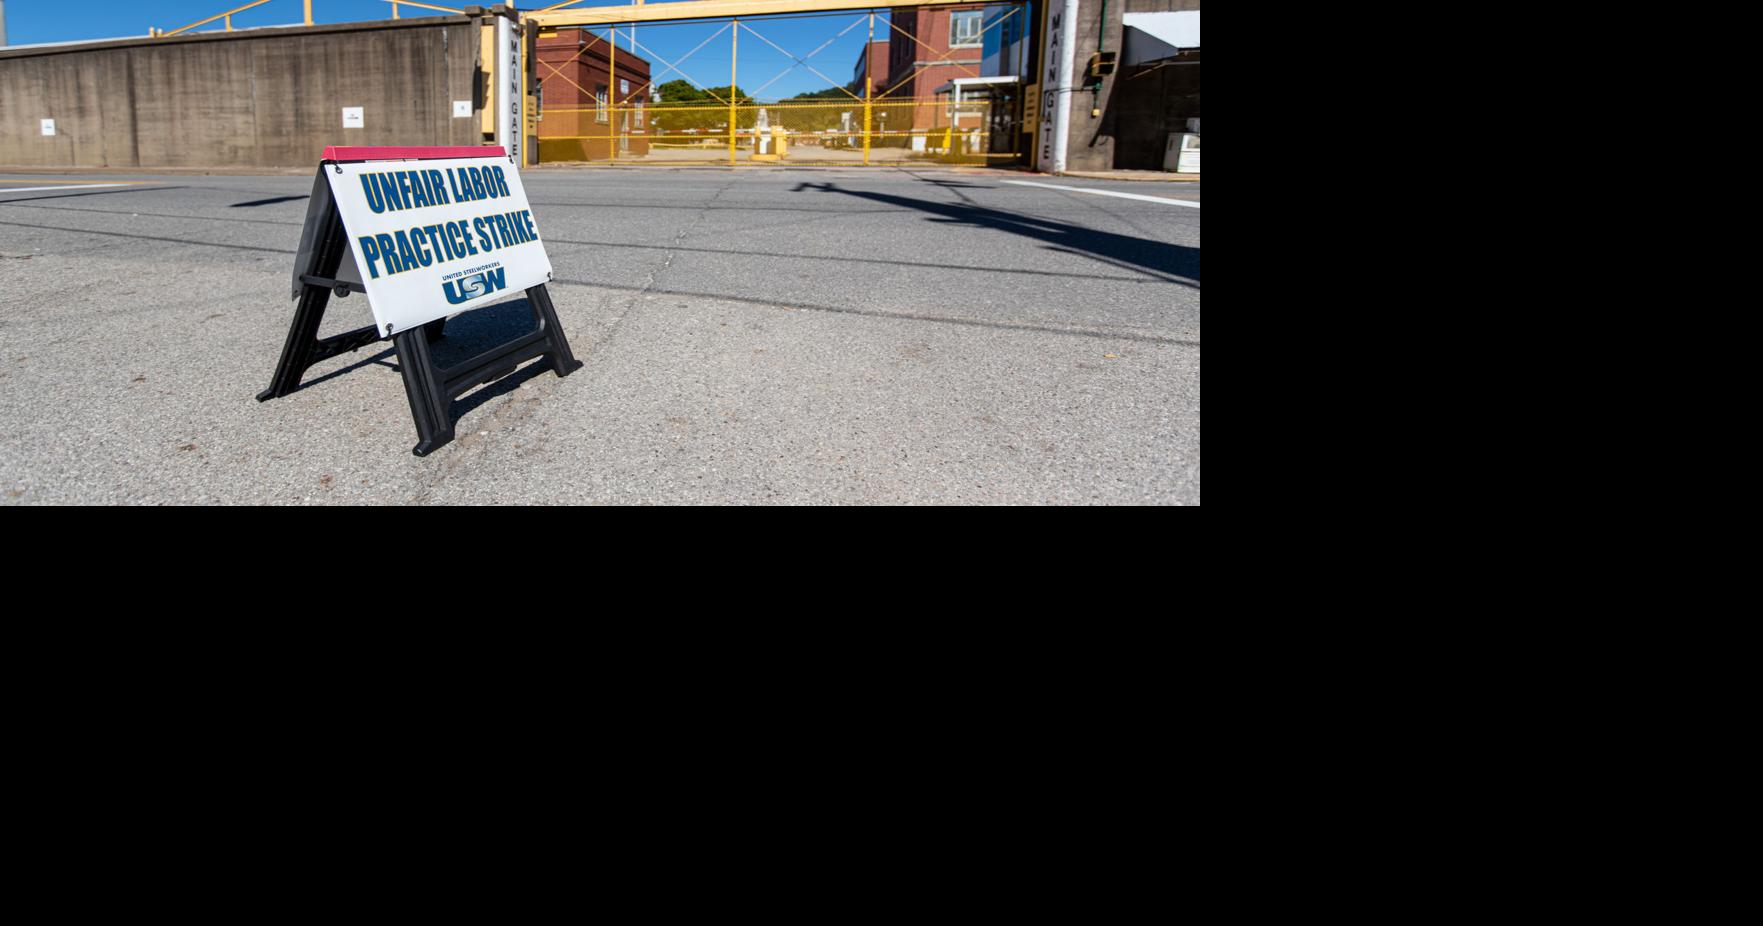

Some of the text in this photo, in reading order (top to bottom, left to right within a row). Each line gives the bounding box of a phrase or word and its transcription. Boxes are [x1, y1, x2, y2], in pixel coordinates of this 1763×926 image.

[510, 39, 518, 94] MAIN
[1043, 13, 1061, 159] MAIN GATE
[360, 165, 511, 214] UNFAIR LABOR
[358, 209, 538, 279] PRACTICE STRIKE
[442, 261, 501, 281] UNITED STEELWORKERS
[442, 267, 506, 304] USW
